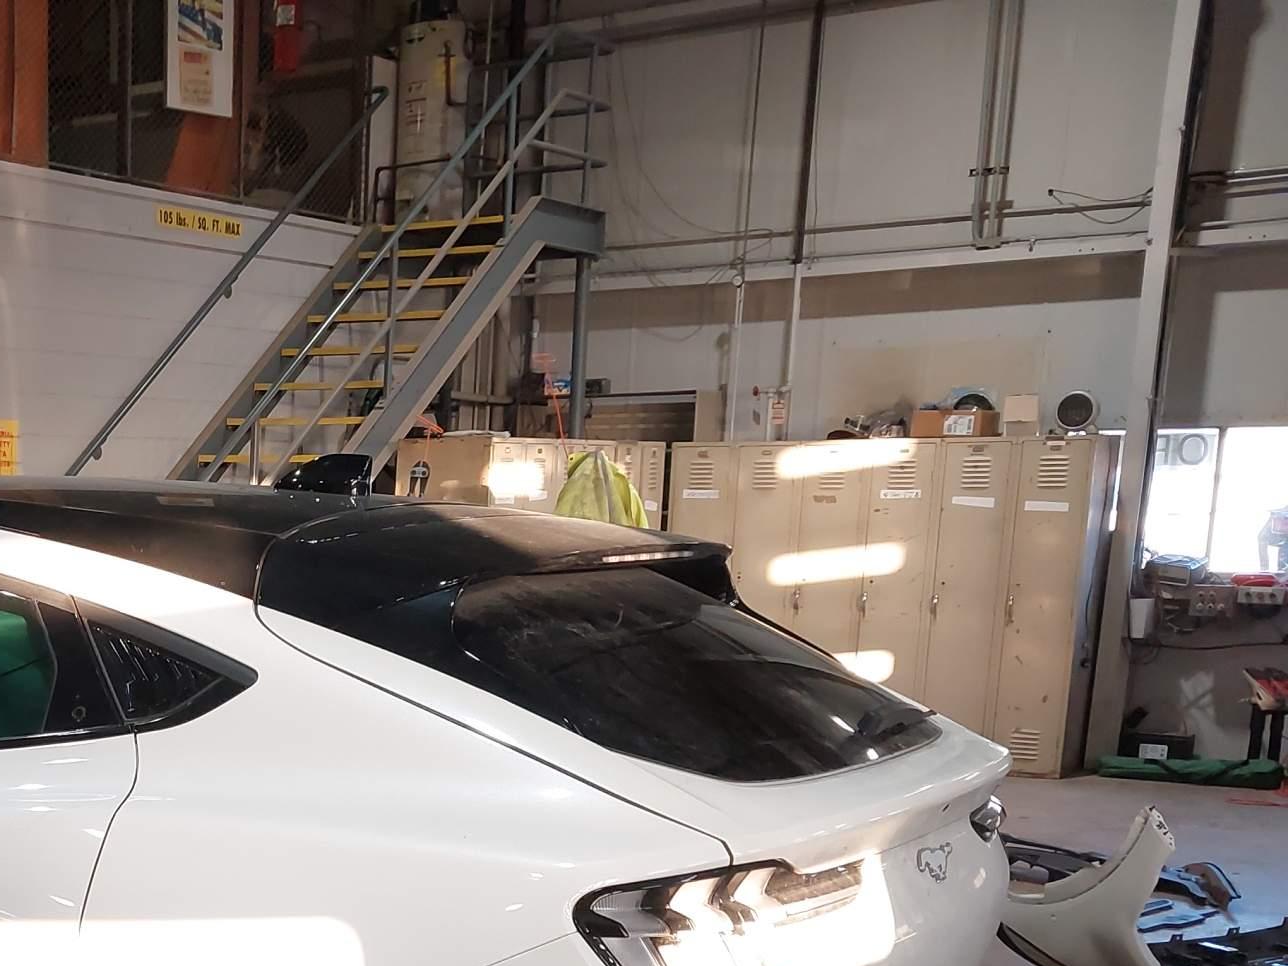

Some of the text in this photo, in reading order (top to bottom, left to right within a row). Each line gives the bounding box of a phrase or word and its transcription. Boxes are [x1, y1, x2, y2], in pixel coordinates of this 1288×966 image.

[159, 209, 173, 225] 105
[176, 211, 189, 227] lbs.
[197, 216, 209, 231] SQ.
[212, 219, 222, 233] FT.
[225, 220, 241, 236] MAX
